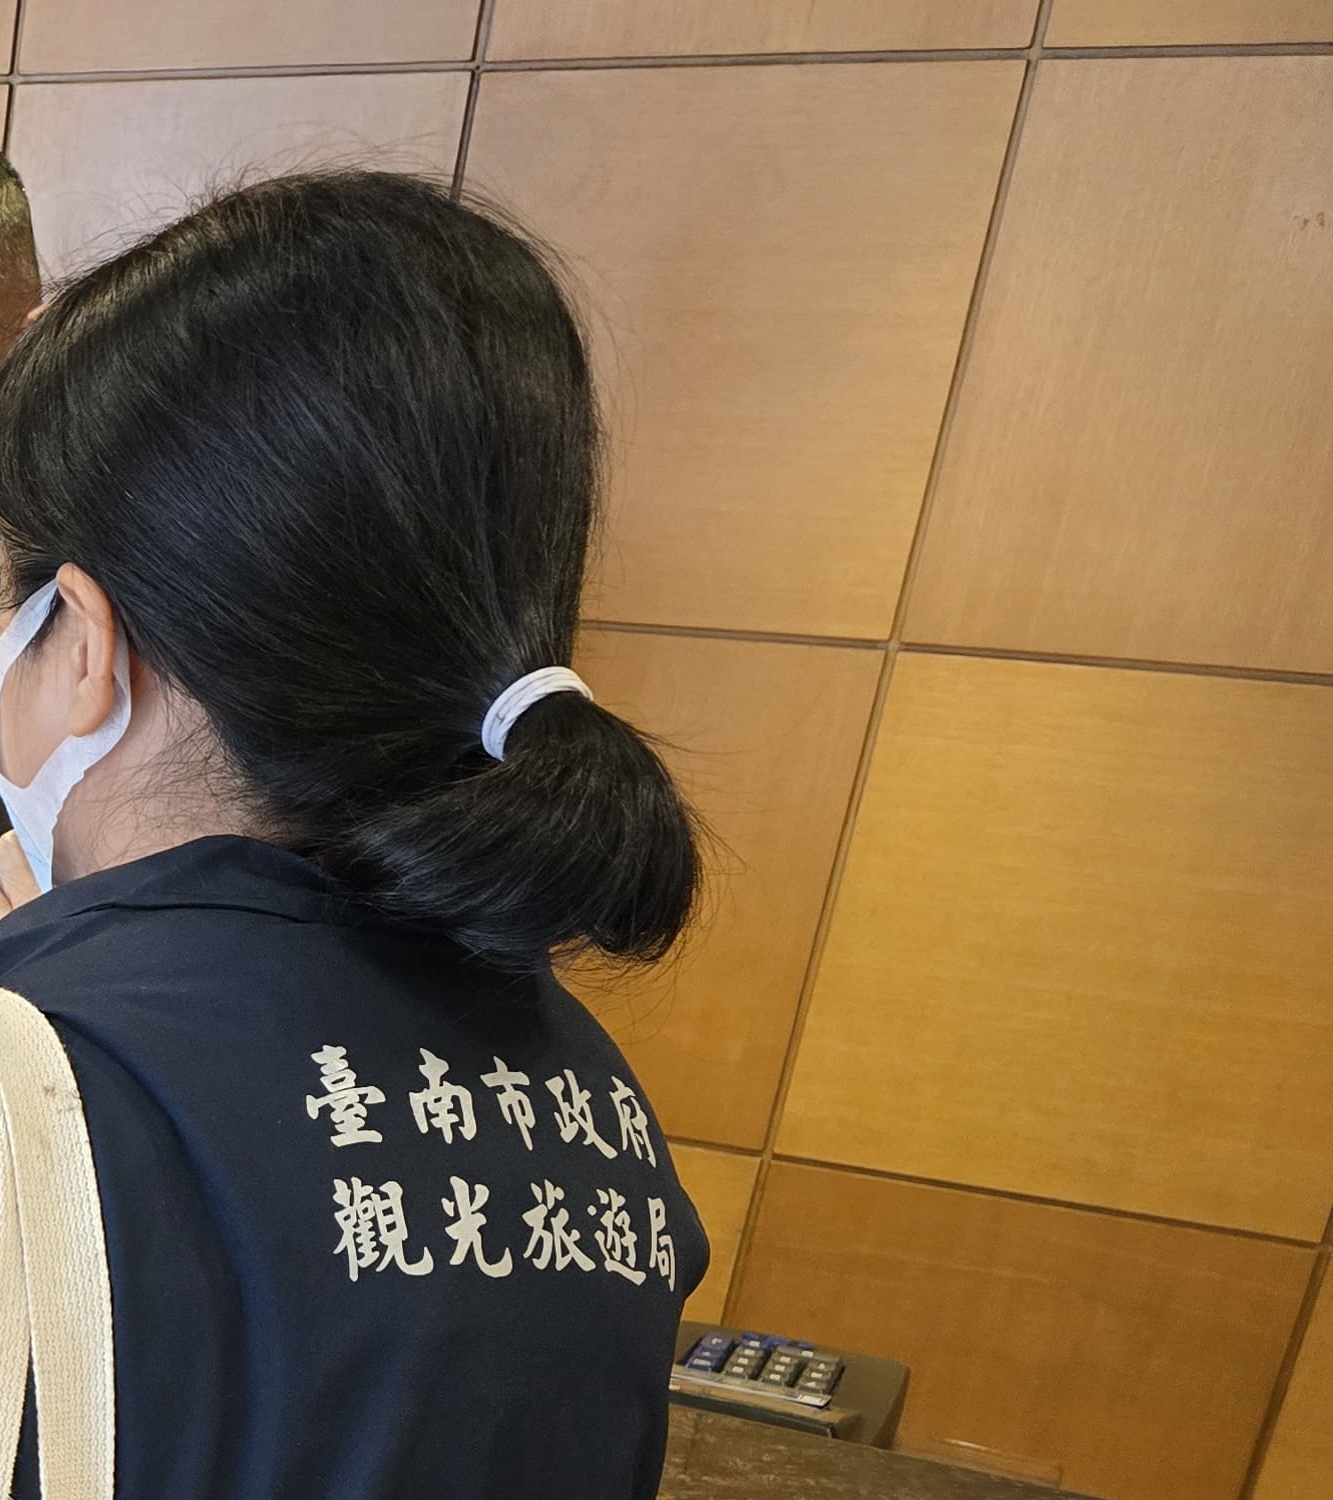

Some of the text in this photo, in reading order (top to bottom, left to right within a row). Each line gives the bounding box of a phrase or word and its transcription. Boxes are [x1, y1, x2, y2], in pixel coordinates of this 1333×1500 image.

[305, 1043, 658, 1168] 臺南市政府
[331, 1176, 677, 1293] 觀光旅遊局
